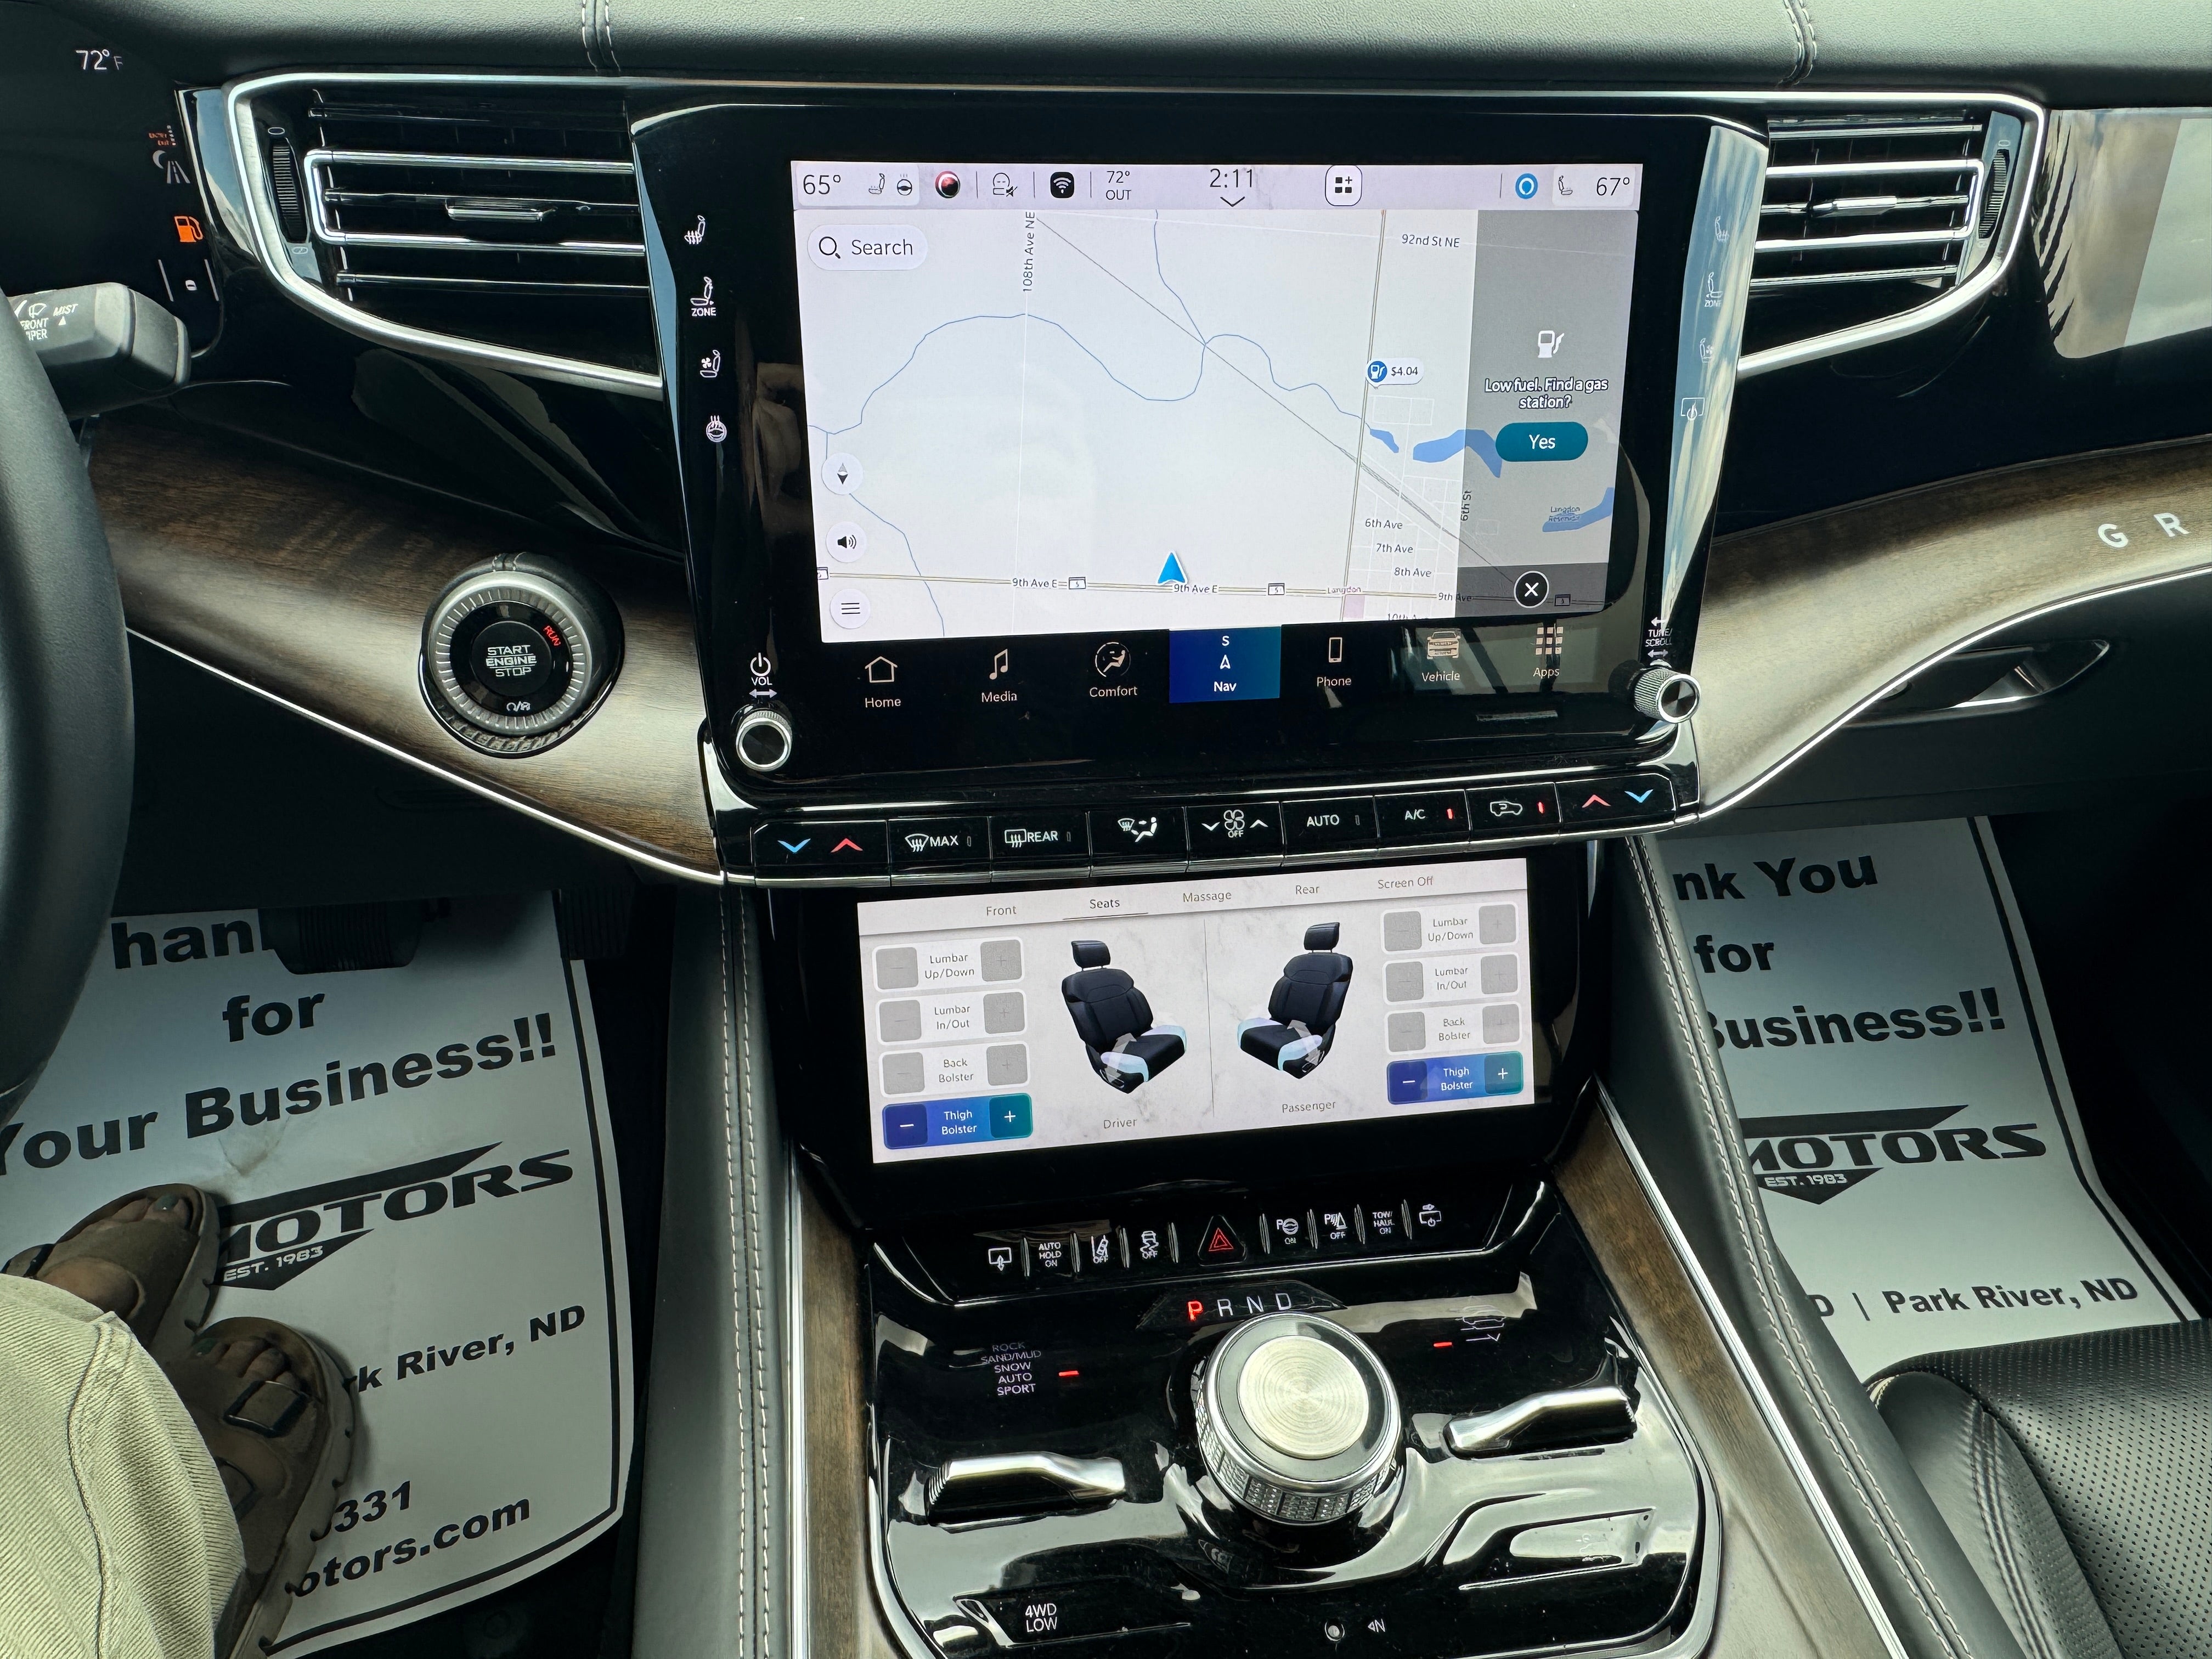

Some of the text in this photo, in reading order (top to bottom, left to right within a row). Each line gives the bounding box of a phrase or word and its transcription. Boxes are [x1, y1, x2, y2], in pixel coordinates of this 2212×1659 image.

[1106, 170, 1130, 184] 72°
[1209, 169, 1255, 189] 2:11
[803, 174, 842, 195] 65°
[1595, 177, 1630, 198] 67°
[1106, 189, 1131, 201] OUT
[1401, 233, 1460, 248] 92nd St NE
[851, 239, 913, 256] Search
[1023, 211, 1035, 292] 108th Ave NE
[53, 304, 78, 317] MIST
[691, 308, 716, 317] ZONE
[1391, 366, 1419, 376] $4.04
[1485, 377, 1608, 394] Low fuel. Find a gas
[1519, 395, 1572, 409] station?
[1529, 434, 1556, 450] Yes
[1365, 518, 1403, 530] 6th Ave
[1376, 543, 1414, 554] 7th Ave
[1394, 567, 1432, 578] 8th Ave
[1012, 578, 1057, 588] 9th Ave E
[1173, 584, 1189, 592] 9th
[1438, 592, 1472, 602] 9th Ave
[544, 625, 561, 646] RUN
[1222, 636, 1230, 646] S
[487, 645, 531, 656] START
[486, 656, 537, 667] ENGINE
[495, 667, 532, 677] STOP
[1421, 671, 1460, 682] Vehicle
[1533, 667, 1560, 679] Apps
[751, 676, 772, 686] VOL
[1214, 681, 1237, 693] Nav
[1317, 676, 1352, 688] Phone
[981, 691, 1018, 703] Media
[1089, 685, 1138, 698] Comfort
[865, 697, 901, 709] Home
[1307, 814, 1340, 827] AUTO
[1404, 808, 1426, 821] A/C
[1026, 831, 1058, 843] REAR
[1228, 830, 1244, 838] OFF
[929, 835, 959, 847] MAX
[1753, 855, 1878, 897] You
[1378, 876, 1434, 889] Screen Off
[1295, 884, 1320, 896] Rear
[1182, 890, 1232, 904] Massage
[1090, 898, 1121, 910] Seats
[986, 905, 1017, 917] Front
[1433, 916, 1469, 928] Lumbar
[1428, 930, 1474, 944] Up/Down
[111, 919, 258, 969] han
[929, 952, 969, 964] Lumbar
[1693, 934, 1775, 974] for
[924, 968, 975, 980] Up/Down
[1435, 966, 1469, 977] Lumbar
[1436, 980, 1468, 991] In/Out
[934, 1005, 970, 1016] Lumbar
[222, 993, 325, 1042] for
[1443, 1017, 1465, 1028] Back
[936, 1019, 970, 1030] In/Out
[1438, 1030, 1471, 1042] Bolster
[943, 1058, 968, 1069] Back
[185, 1012, 556, 1139] Business!!
[939, 1071, 974, 1083] Bolster
[1443, 1066, 1470, 1078] Thigh
[1441, 1080, 1474, 1091] Bolster
[1282, 1101, 1336, 1114] Passenger
[944, 1109, 973, 1122] Thigh
[941, 1124, 978, 1135] Bolster
[1103, 1117, 1138, 1130] Driver
[1764, 1173, 1848, 1188] EST. 1983
[1330, 1231, 1346, 1240] OFF
[1379, 1227, 1391, 1235] ON
[1039, 1242, 1061, 1251] AUTO
[1039, 1250, 1062, 1260] HOLD
[1093, 1255, 1108, 1264] OFF
[1142, 1250, 1158, 1260] OFF
[223, 1245, 324, 1282] EST. 1983
[1882, 1288, 1971, 1314] Park
[1972, 1285, 2081, 1310] River,
[2080, 1277, 2138, 1302] ND
[1188, 1293, 1292, 1321] P R N D
[397, 1333, 515, 1380] River,
[529, 1305, 585, 1342] ND
[992, 1341, 1026, 1352] ROCK
[980, 1350, 1042, 1365] SAND/MUD
[994, 1361, 1031, 1373] SNOW
[998, 1373, 1032, 1384] AUTO
[996, 1383, 1036, 1396] SPORT
[294, 1499, 530, 1597] otors.com
[1025, 1603, 1057, 1618] 4WD
[1026, 1616, 1058, 1633] LOW
